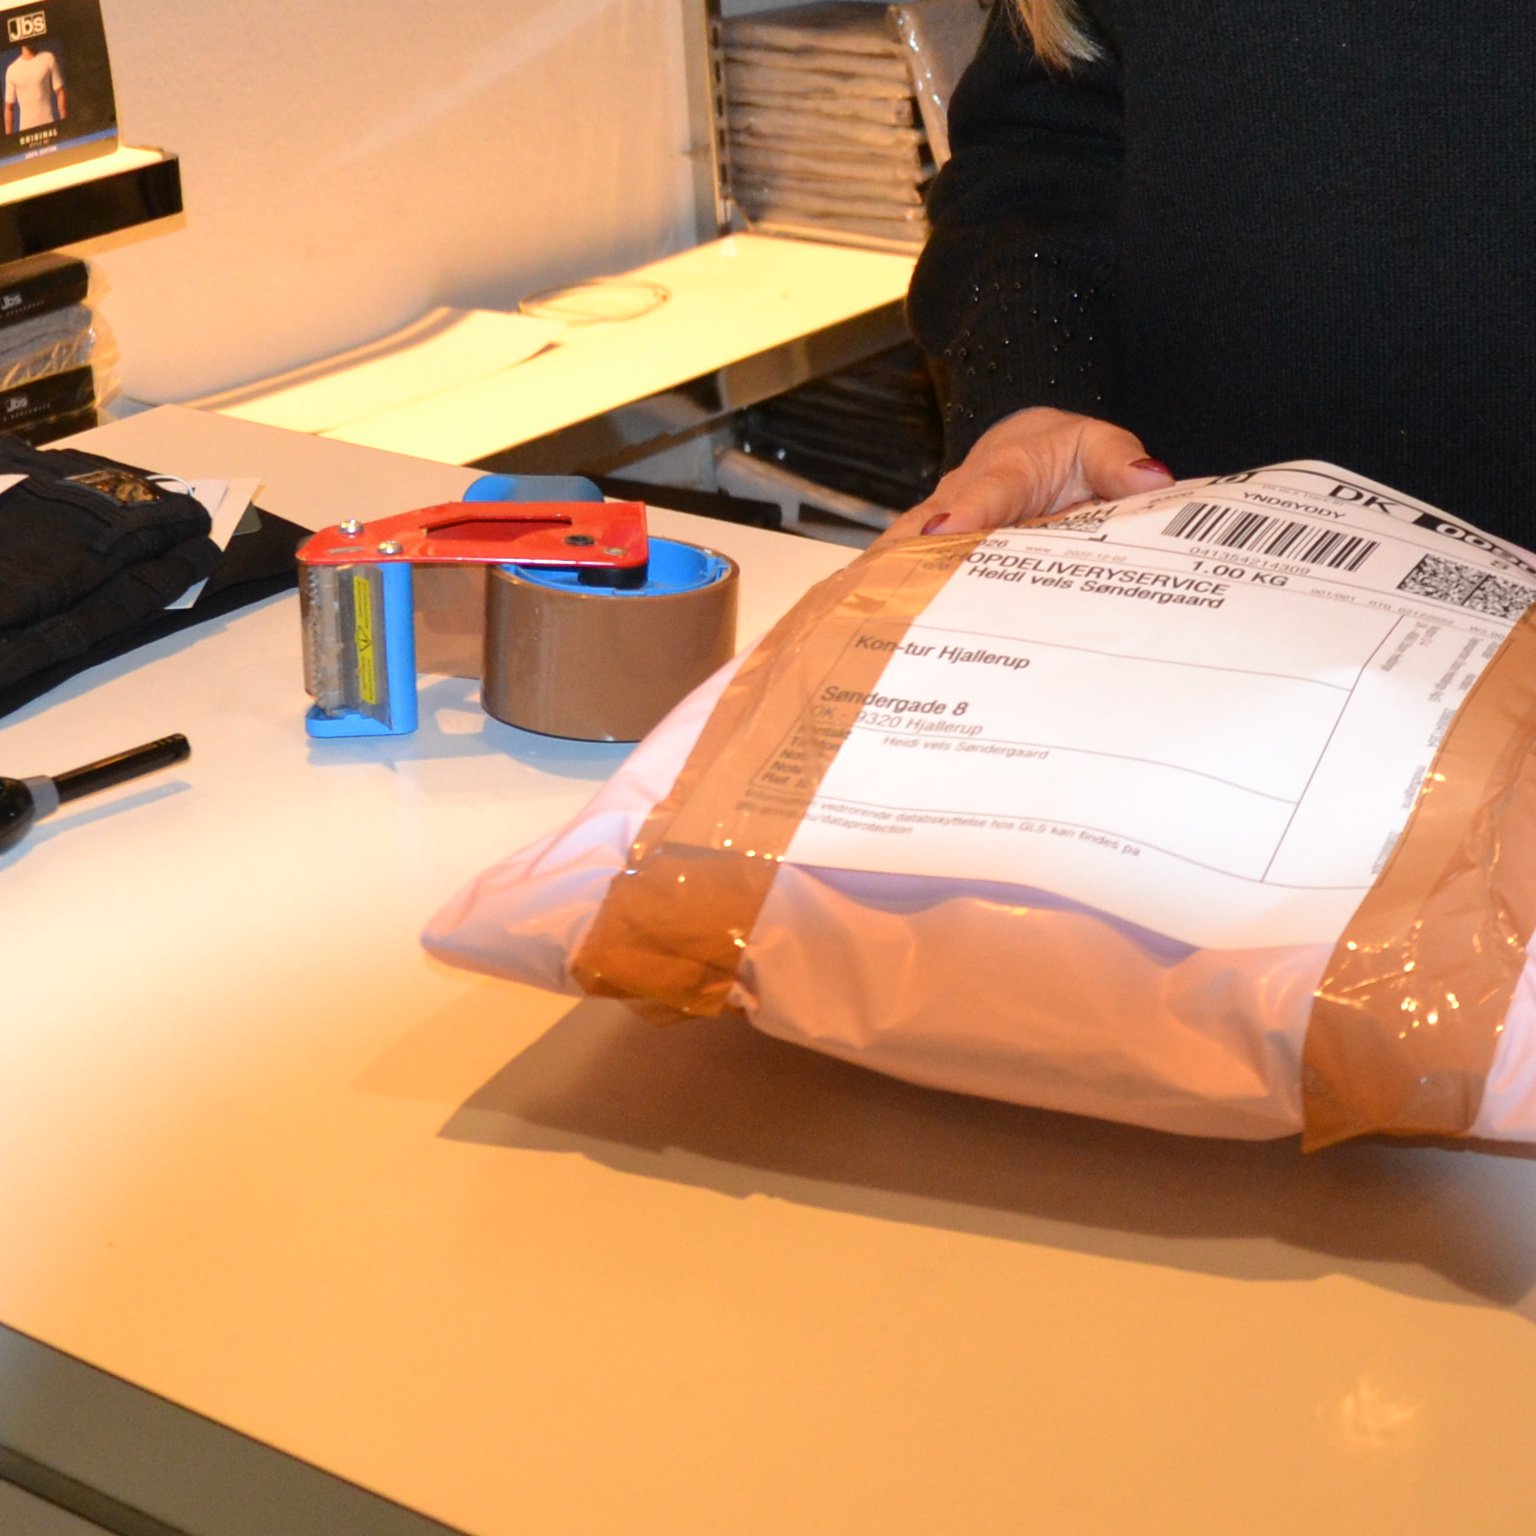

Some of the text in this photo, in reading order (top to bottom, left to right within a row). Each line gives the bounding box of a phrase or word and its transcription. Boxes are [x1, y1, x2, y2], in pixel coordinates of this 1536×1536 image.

[1328, 484, 1401, 515] DK
[946, 550, 1231, 596] OPDELIVERYSERVICE
[968, 565, 1026, 583] Heidi
[1080, 581, 1227, 609] Søndergaard
[1192, 561, 1290, 586] 1.00 KG
[855, 635, 1031, 670] Kon-tur Hjallerup
[821, 686, 969, 717] Søndergade 8
[904, 717, 984, 738] Hjallerup
